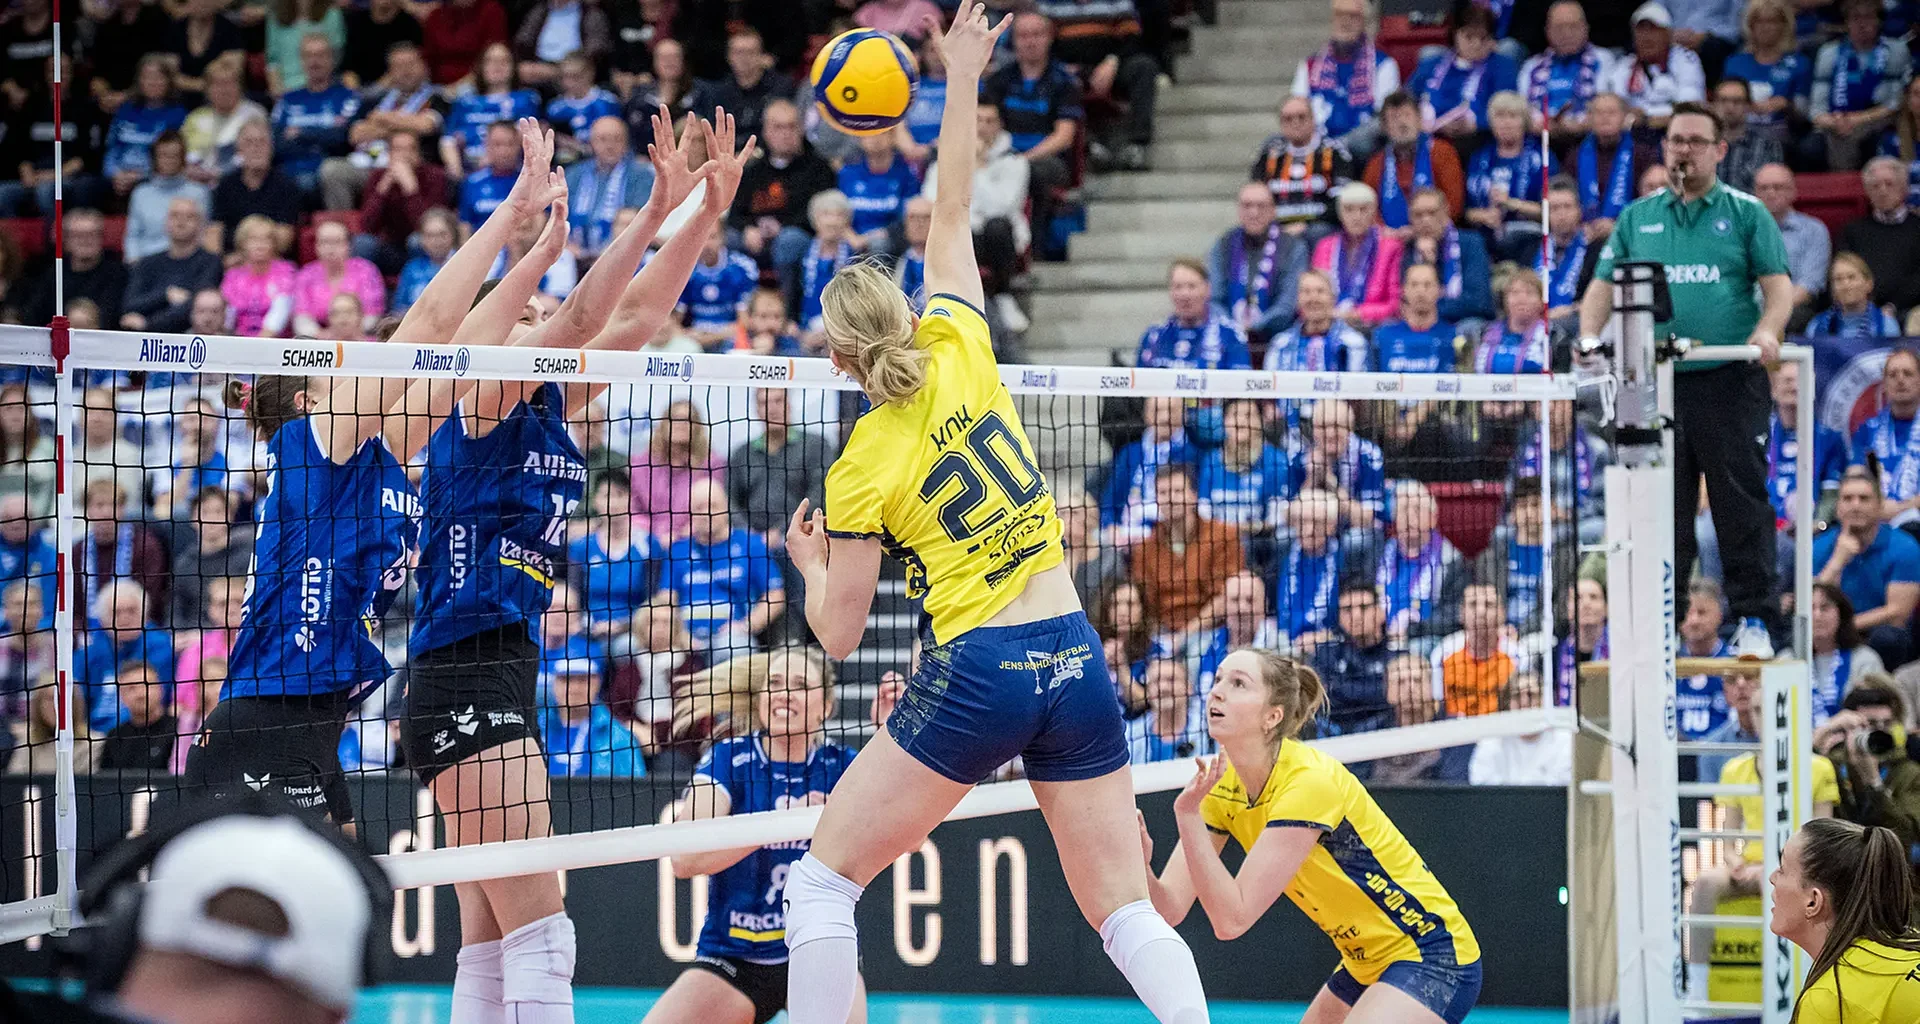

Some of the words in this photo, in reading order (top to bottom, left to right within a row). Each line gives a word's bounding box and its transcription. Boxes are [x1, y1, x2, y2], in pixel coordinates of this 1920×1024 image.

[139, 338, 187, 363] Allianz
[281, 349, 334, 368] SCHARR
[412, 349, 453, 371] Allianz
[533, 357, 578, 374] SCHARR
[645, 356, 680, 377] Allianz
[749, 364, 787, 381] SCHARR
[918, 409, 1043, 544] 20
[999, 660, 1024, 671] JENS
